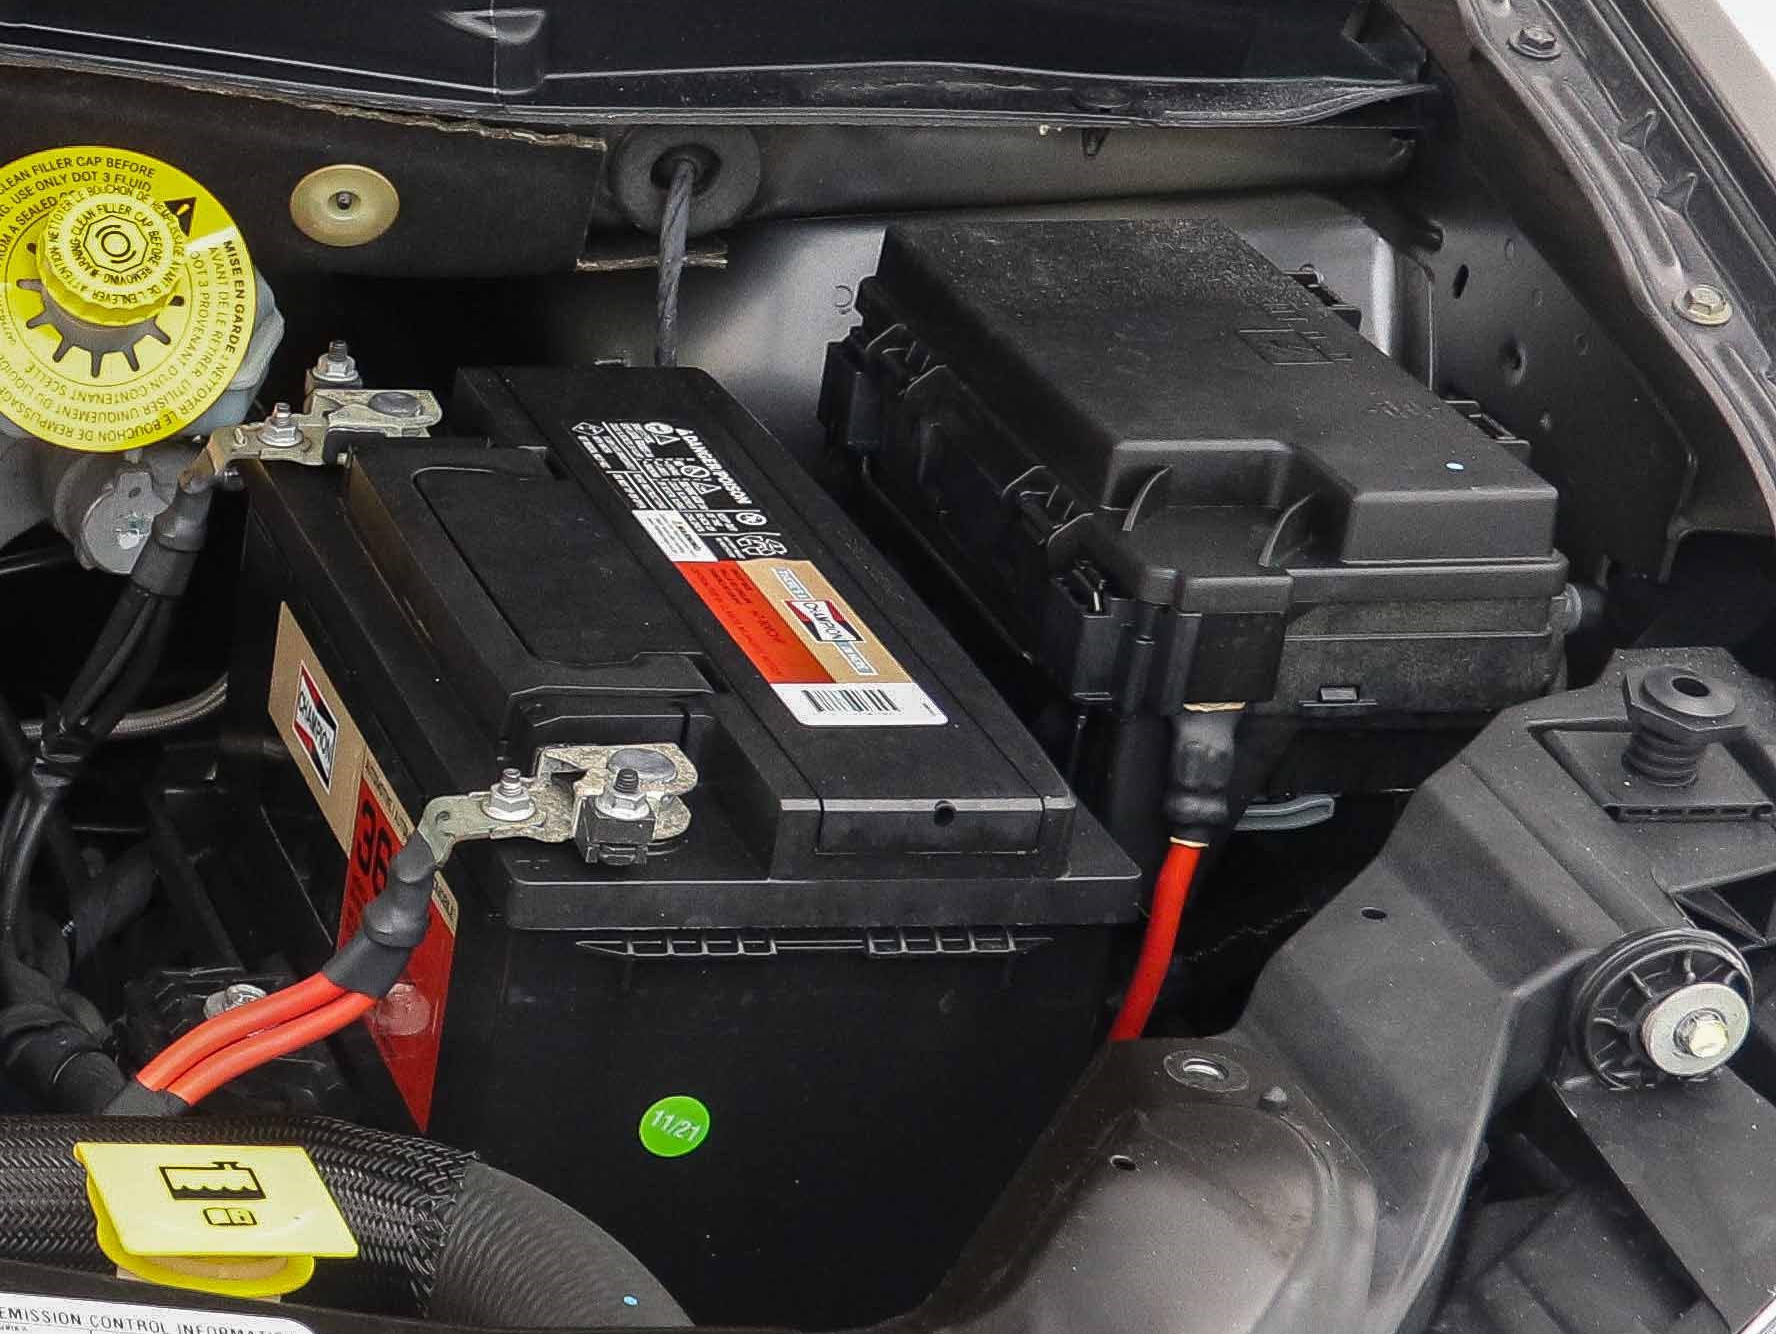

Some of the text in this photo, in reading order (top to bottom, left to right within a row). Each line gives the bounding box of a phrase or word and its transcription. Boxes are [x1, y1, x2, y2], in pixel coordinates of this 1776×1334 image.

[32, 158, 73, 175] FILLER
[76, 156, 102, 167] CAP
[105, 157, 156, 178] BEFORE
[11, 186, 34, 204] USE
[35, 173, 69, 192] ONLY
[72, 172, 98, 183] DOT
[103, 172, 110, 183] 3
[114, 173, 152, 192] FLUID
[10, 226, 19, 237] A
[15, 198, 58, 226] SEALED
[96, 203, 132, 215] FILLER
[134, 212, 153, 227] CAP
[71, 209, 96, 235] CLEAN
[148, 230, 161, 266] BEFORE
[224, 240, 242, 276] MISE
[103, 266, 152, 284] REMOVING
[208, 247, 228, 285] AVANT
[198, 280, 209, 288] 3
[234, 280, 245, 299] EN
[217, 292, 229, 307] DE
[180, 292, 210, 366] PROVENANT
[215, 311, 226, 327] LE
[71, 386, 148, 405] CONTENANT
[142, 378, 191, 415] UTILISER
[180, 363, 229, 415] NETTOYER
[55, 402, 139, 424] UNIQUEMENT
[162, 408, 178, 425] LE
[81, 429, 94, 441] DE
[98, 418, 162, 443] BOUCHON
[803, 602, 844, 640] CHAMPION
[297, 689, 335, 764] CHAMPION
[651, 1110, 701, 1142] 11/21
[90, 1314, 169, 1334] CONTROL
